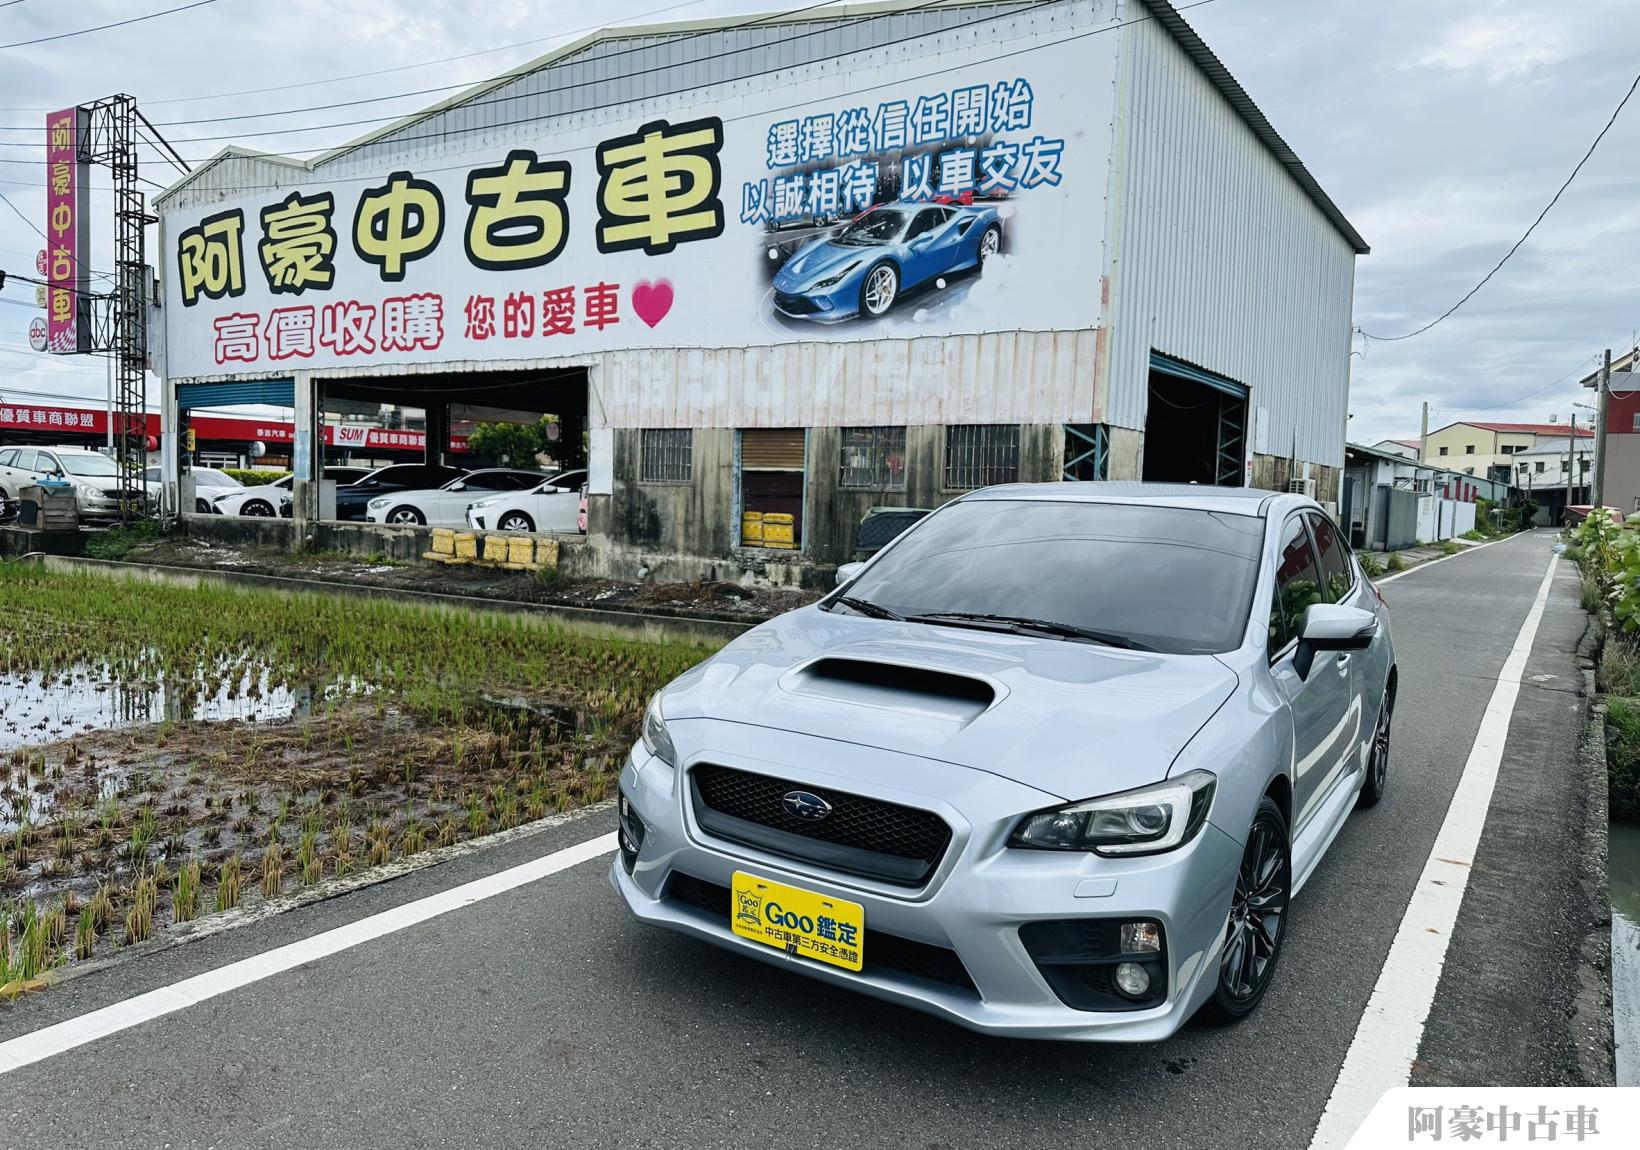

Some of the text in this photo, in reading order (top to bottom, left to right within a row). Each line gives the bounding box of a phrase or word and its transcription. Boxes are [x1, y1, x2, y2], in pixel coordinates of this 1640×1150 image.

[767, 78, 1034, 169] 選擇從信任開始
[740, 136, 1065, 225] 以誠相待 以車交友
[52, 117, 72, 323] 阿豪中古車
[178, 116, 725, 307] 阿豪中古車
[31, 322, 46, 338] abc
[214, 282, 620, 364] 高價收購 您的愛車
[0, 408, 94, 427] 優質車商聯盟
[339, 428, 363, 441] SUM
[740, 895, 759, 907] Goo
[765, 902, 858, 947] Goo 鑑定
[765, 926, 858, 964] 中古車第三方安全憑證
